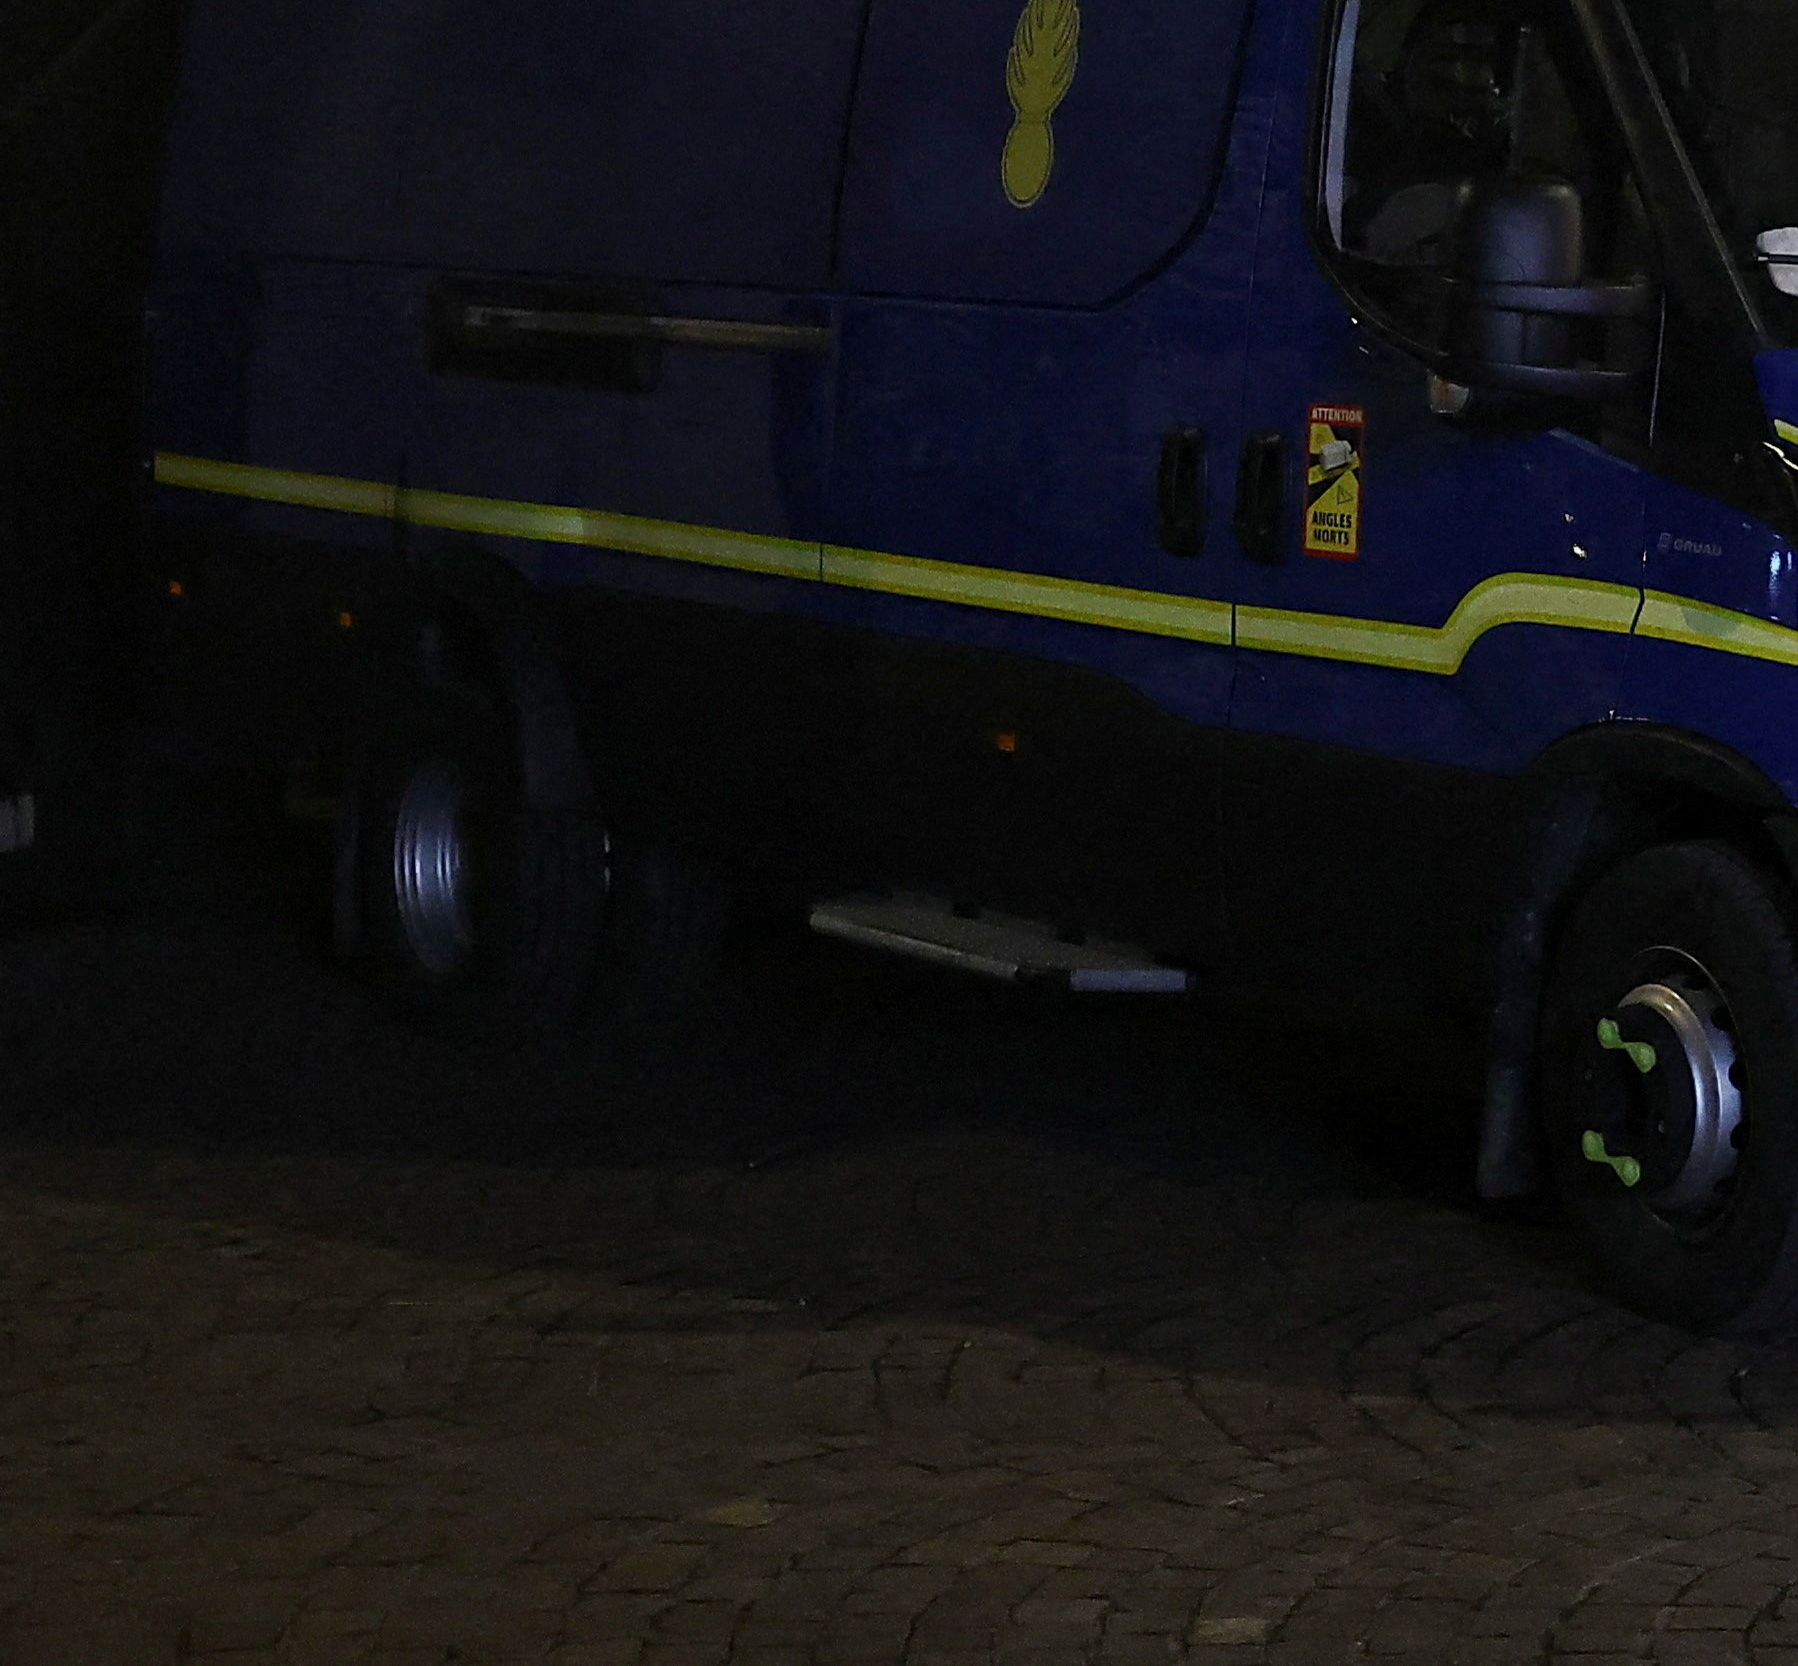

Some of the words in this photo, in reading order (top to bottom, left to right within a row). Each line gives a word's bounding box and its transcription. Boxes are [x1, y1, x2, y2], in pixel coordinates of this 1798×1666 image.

[1311, 407, 1364, 423] ATTENTION
[1312, 510, 1352, 529] ANGLES
[1313, 528, 1350, 545] MORTS
